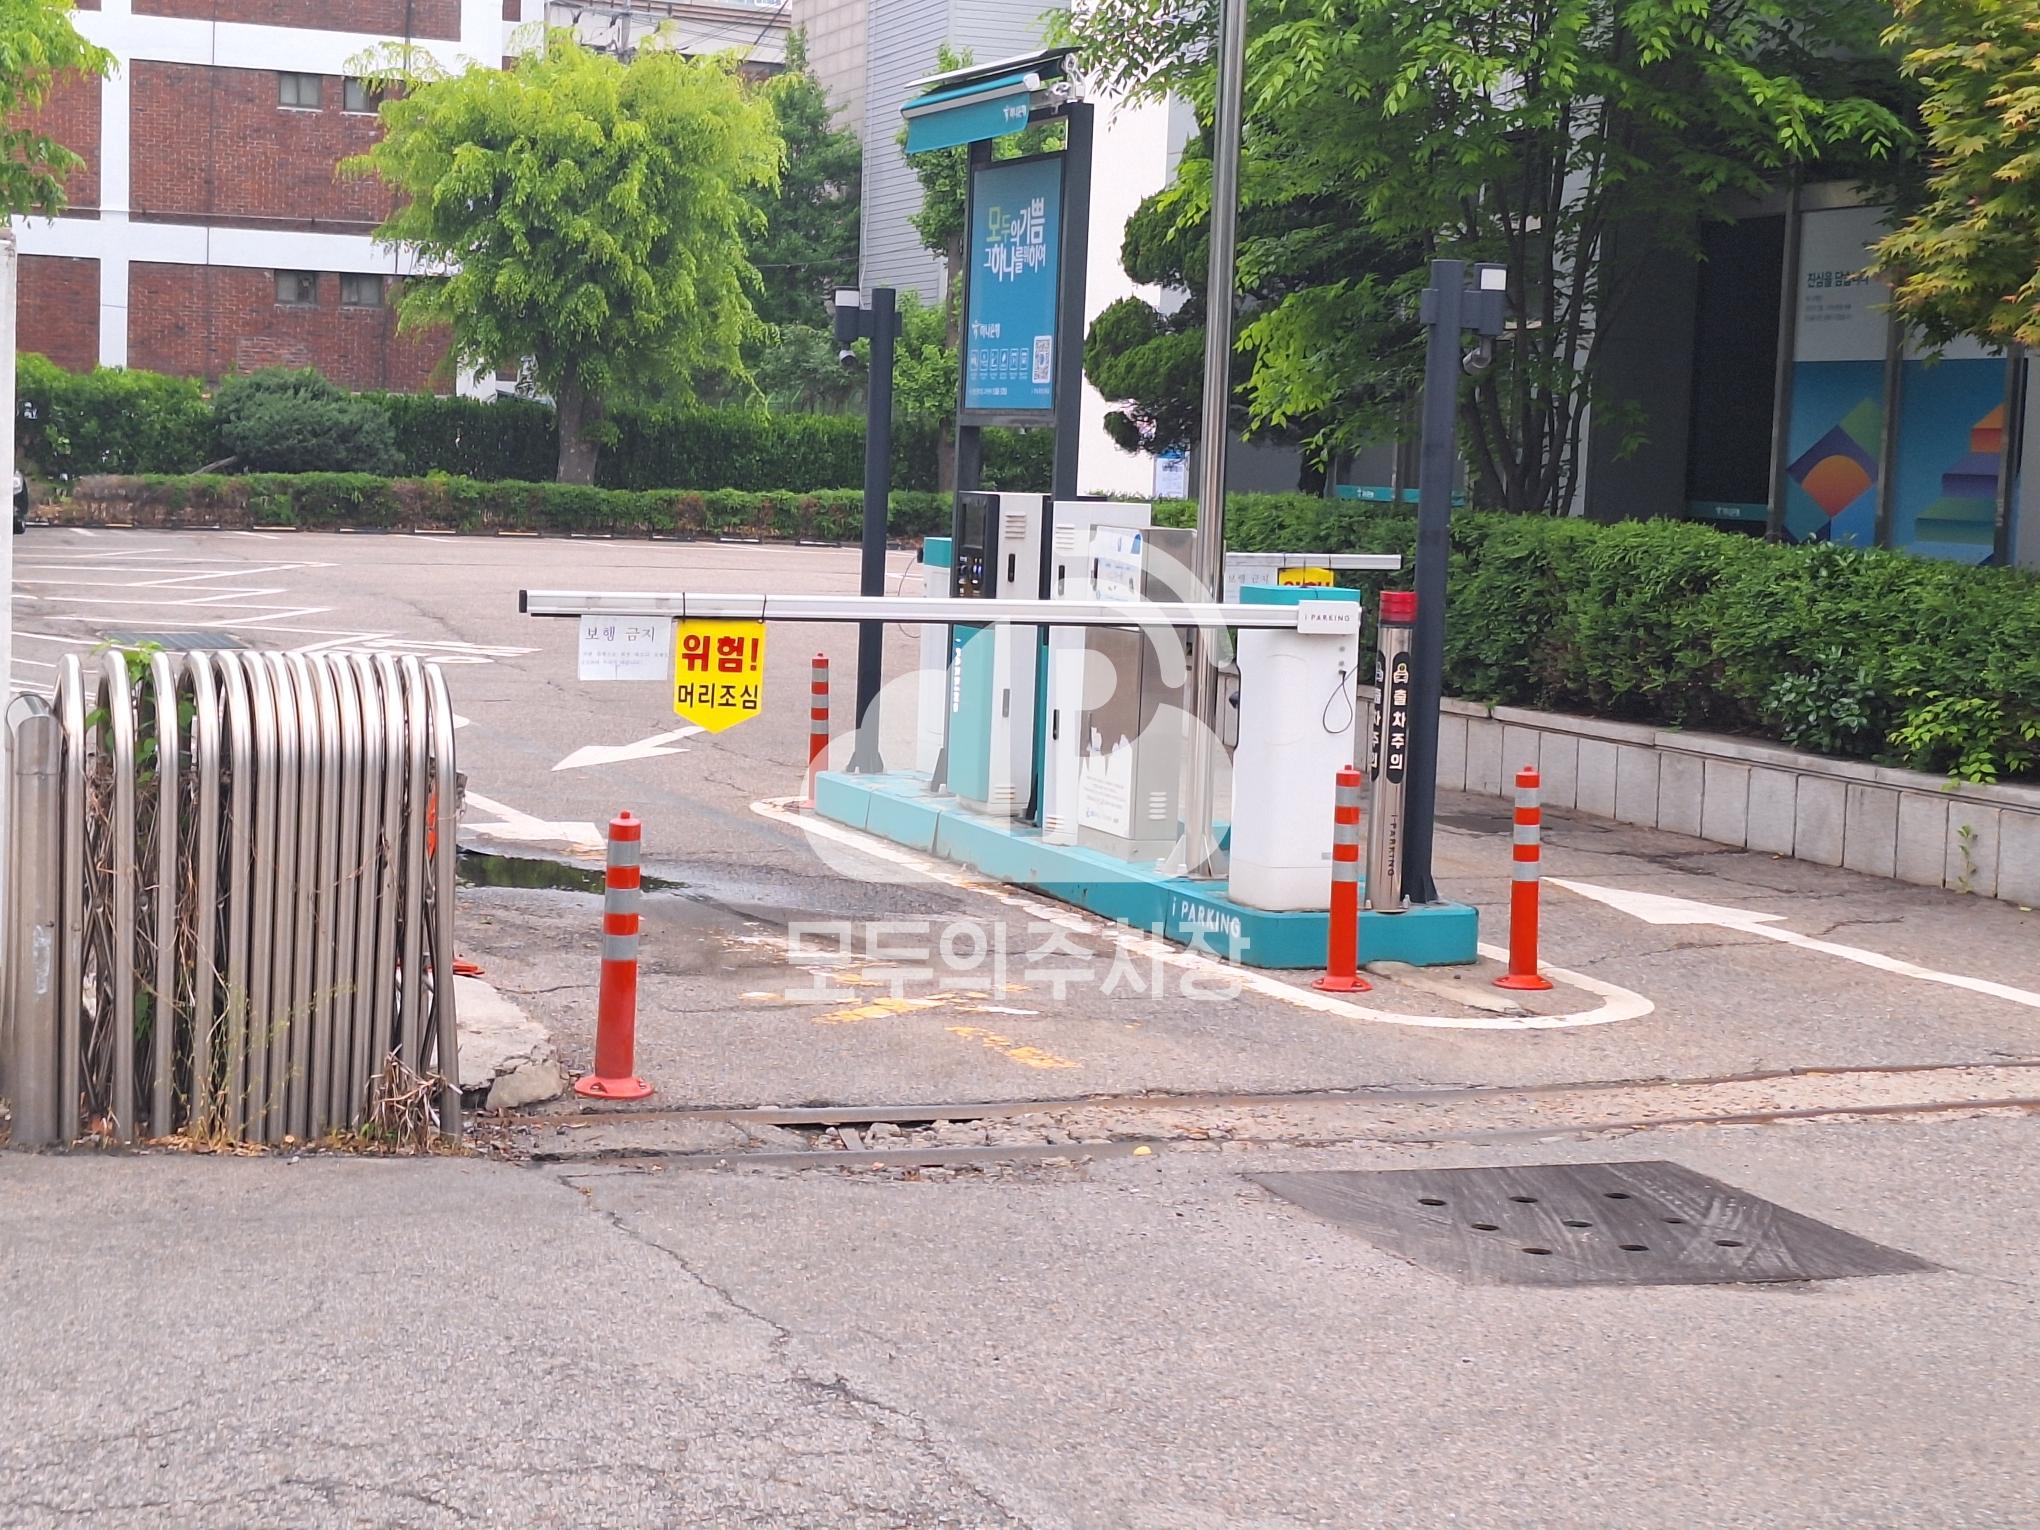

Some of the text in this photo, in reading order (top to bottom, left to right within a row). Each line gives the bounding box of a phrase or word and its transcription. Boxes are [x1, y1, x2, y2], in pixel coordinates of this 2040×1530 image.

[585, 626, 655, 643] 보행 금지
[682, 634, 759, 673] 위험!
[678, 682, 758, 710] 머리조심
[1389, 688, 1408, 771] 출차주의
[1181, 900, 1242, 938] PARKING
